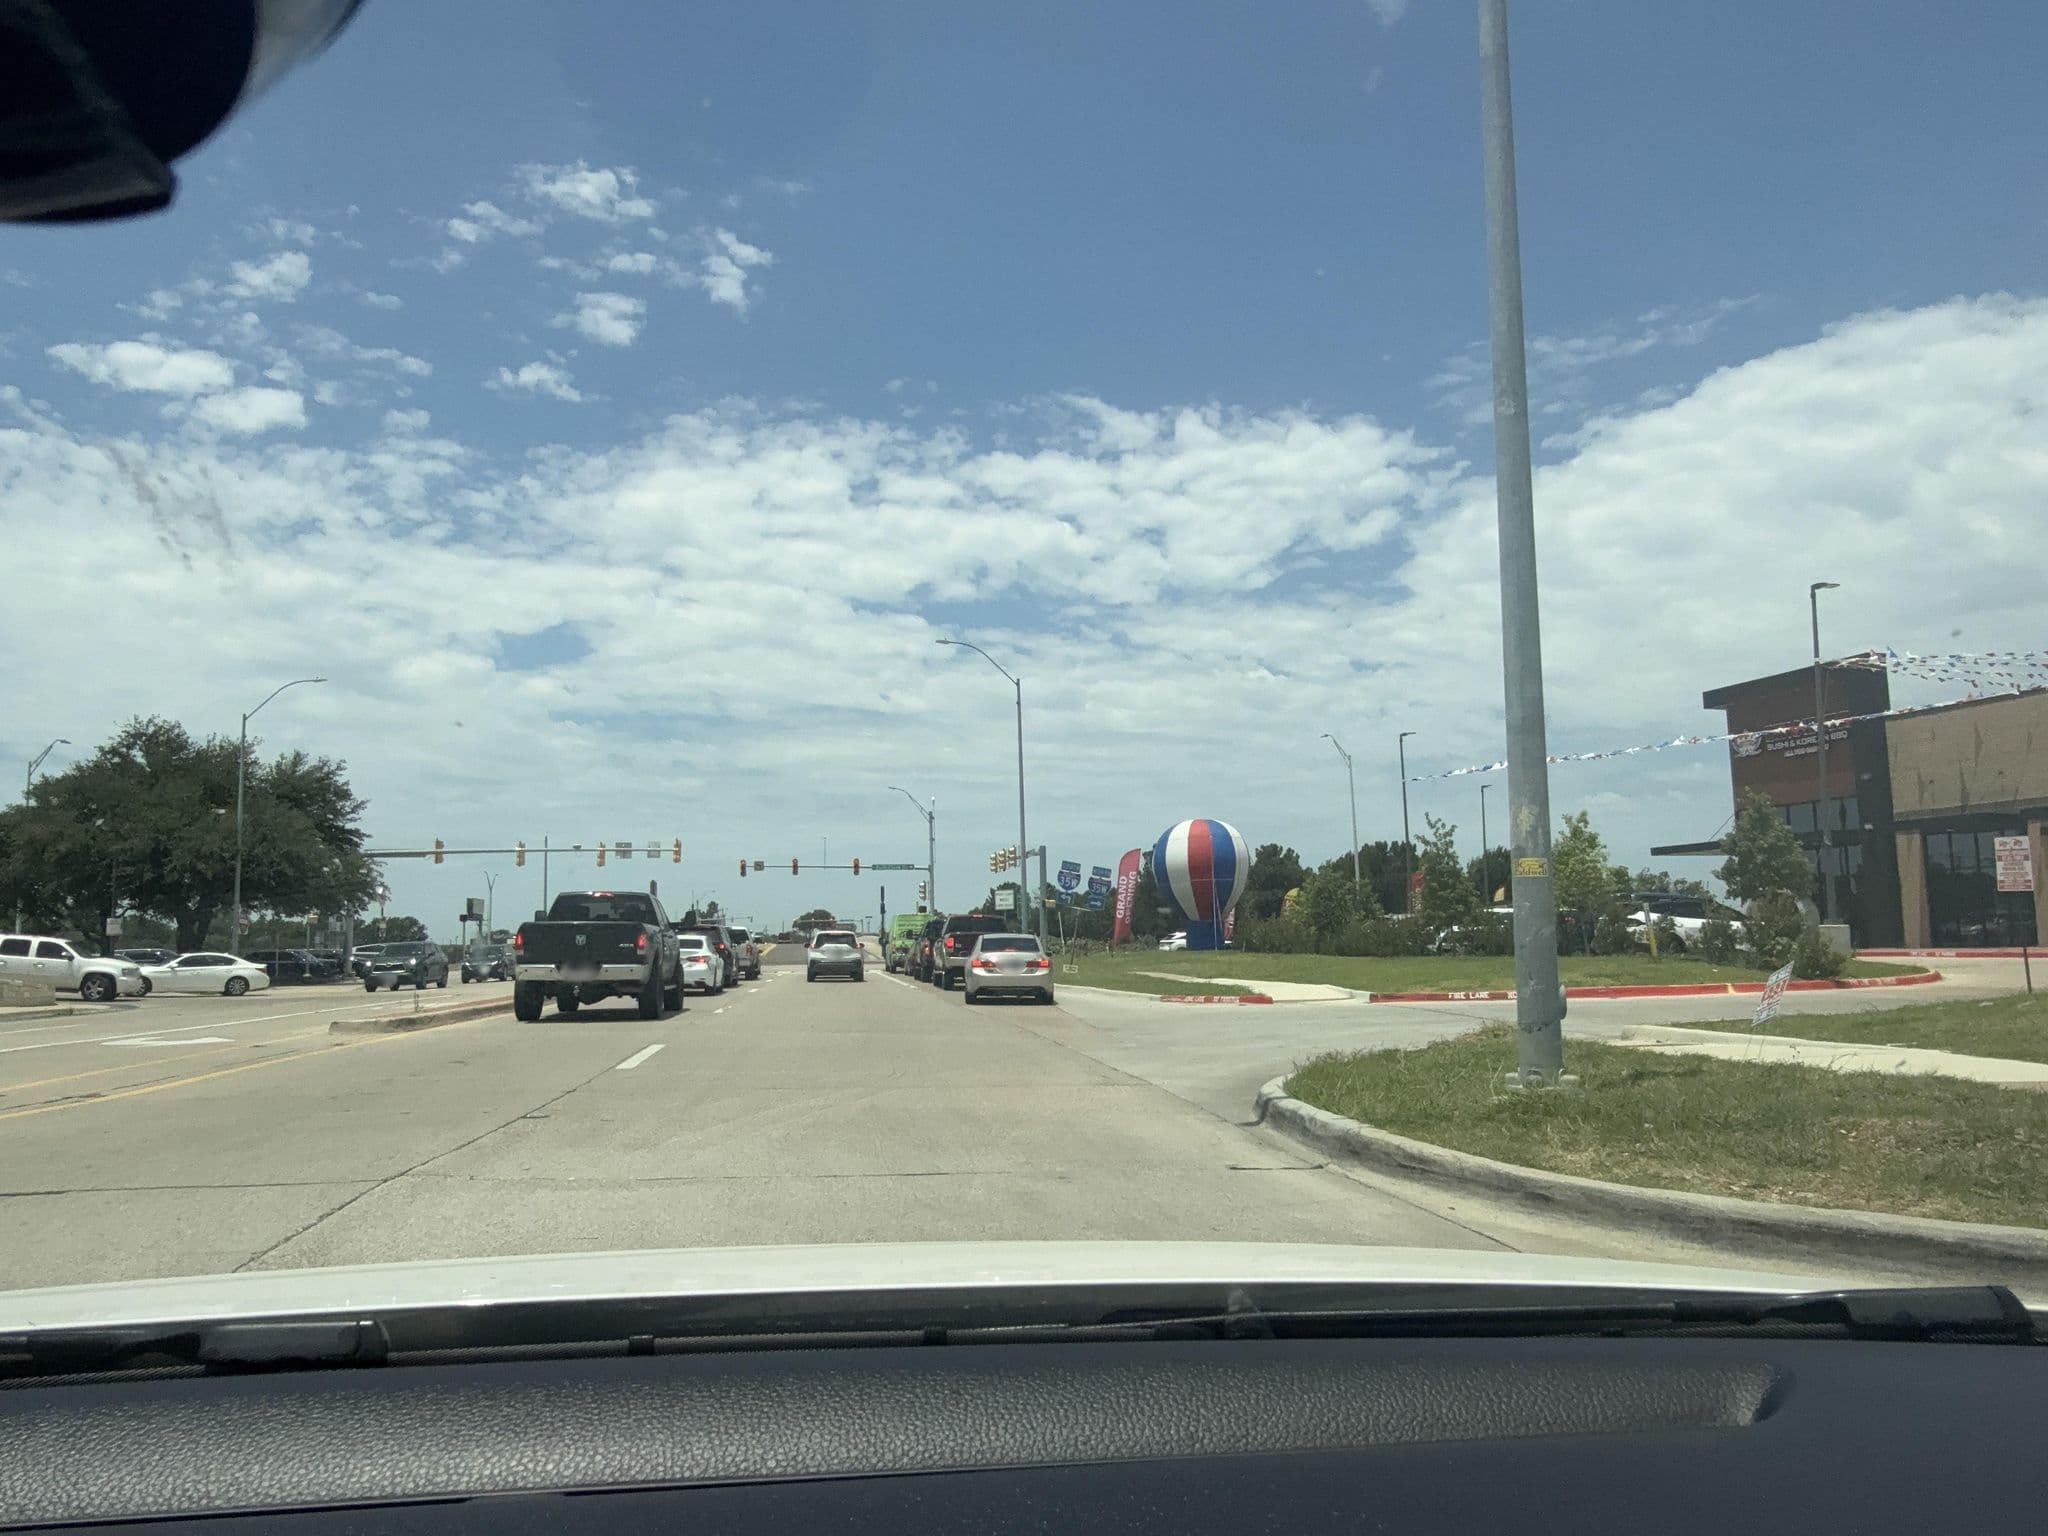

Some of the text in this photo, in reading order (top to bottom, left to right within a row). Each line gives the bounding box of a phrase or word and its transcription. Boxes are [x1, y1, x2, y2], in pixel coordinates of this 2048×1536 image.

[1767, 741, 1789, 751] SUSHI
[1797, 733, 1829, 746] KOREN
[1830, 730, 1848, 740] BBQ
[1060, 876, 1079, 888] 35W
[1116, 876, 1128, 919] GRAND
[1469, 991, 1490, 999] LANE
